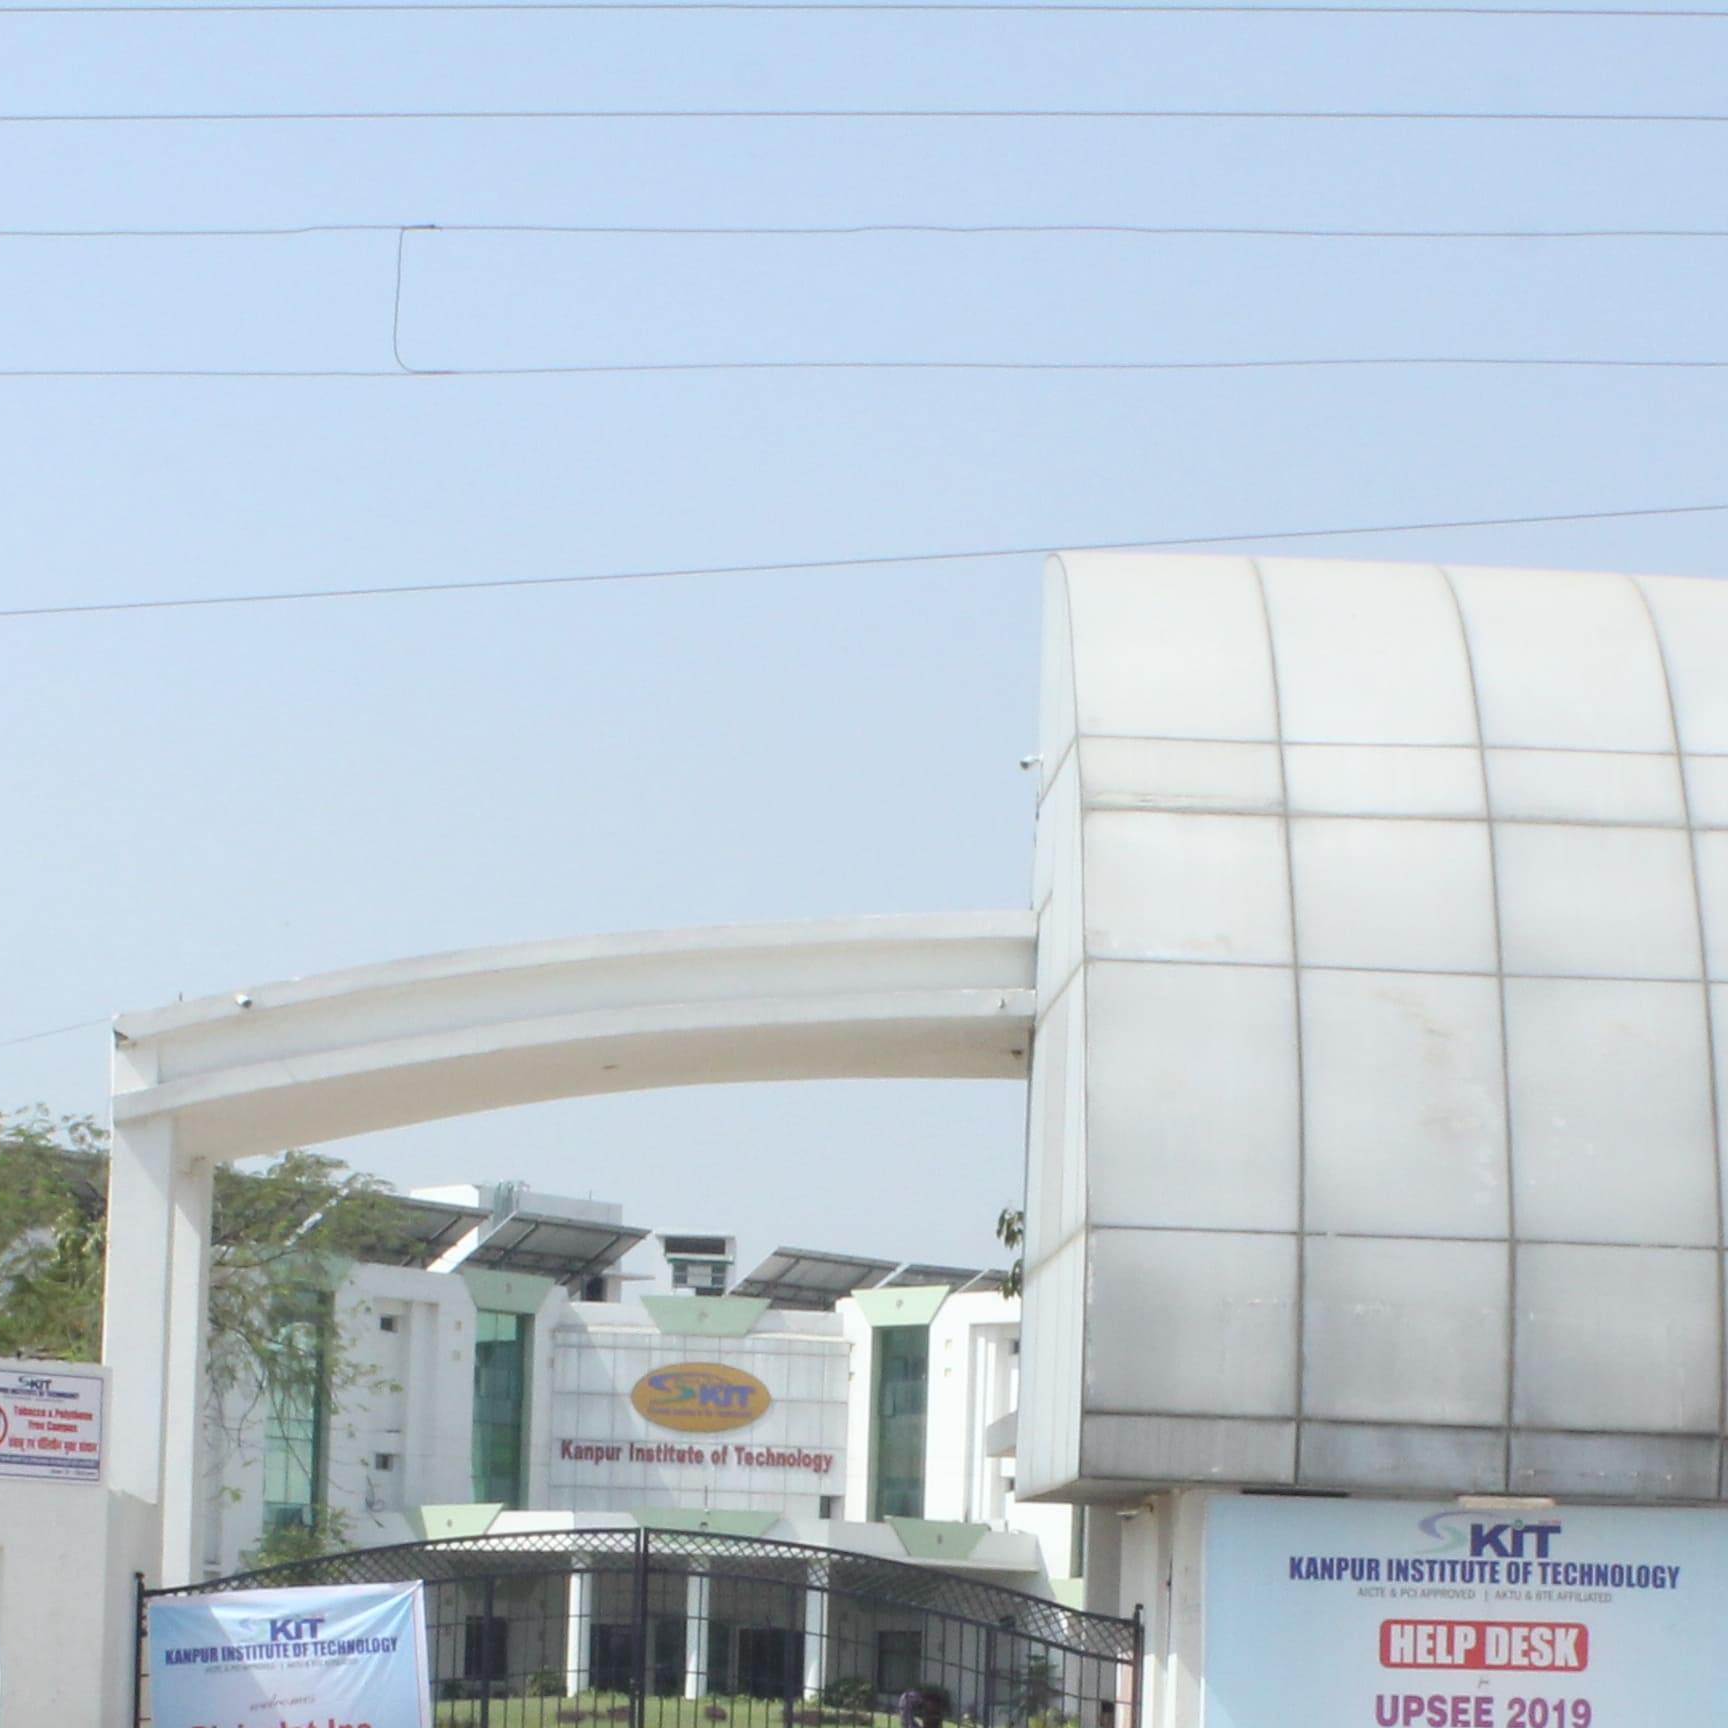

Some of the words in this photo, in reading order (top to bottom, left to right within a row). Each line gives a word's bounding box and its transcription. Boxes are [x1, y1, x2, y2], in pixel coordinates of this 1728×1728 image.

[561, 1440, 621, 1465] Kanpur
[629, 1443, 704, 1465] Institute
[711, 1446, 728, 1465] of
[735, 1446, 833, 1473] Technology
[1289, 1556, 1380, 1582] KANPUR
[1387, 1559, 1499, 1584] INSTITUTE
[1506, 1561, 1533, 1585] OF
[1538, 1562, 1680, 1589] TECHNOLOGY
[1421, 1587, 1476, 1600] APPROVED
[1495, 1590, 1522, 1601] AKTU
[165, 1647, 218, 1666] KANPUR
[222, 1642, 290, 1662] INSTITUTE
[293, 1642, 309, 1658] OF
[313, 1636, 397, 1656] TECHNOLOGY
[1389, 1624, 1476, 1665] HELP
[1485, 1626, 1579, 1667] DESK
[1375, 1694, 1494, 1728] UPSEE
